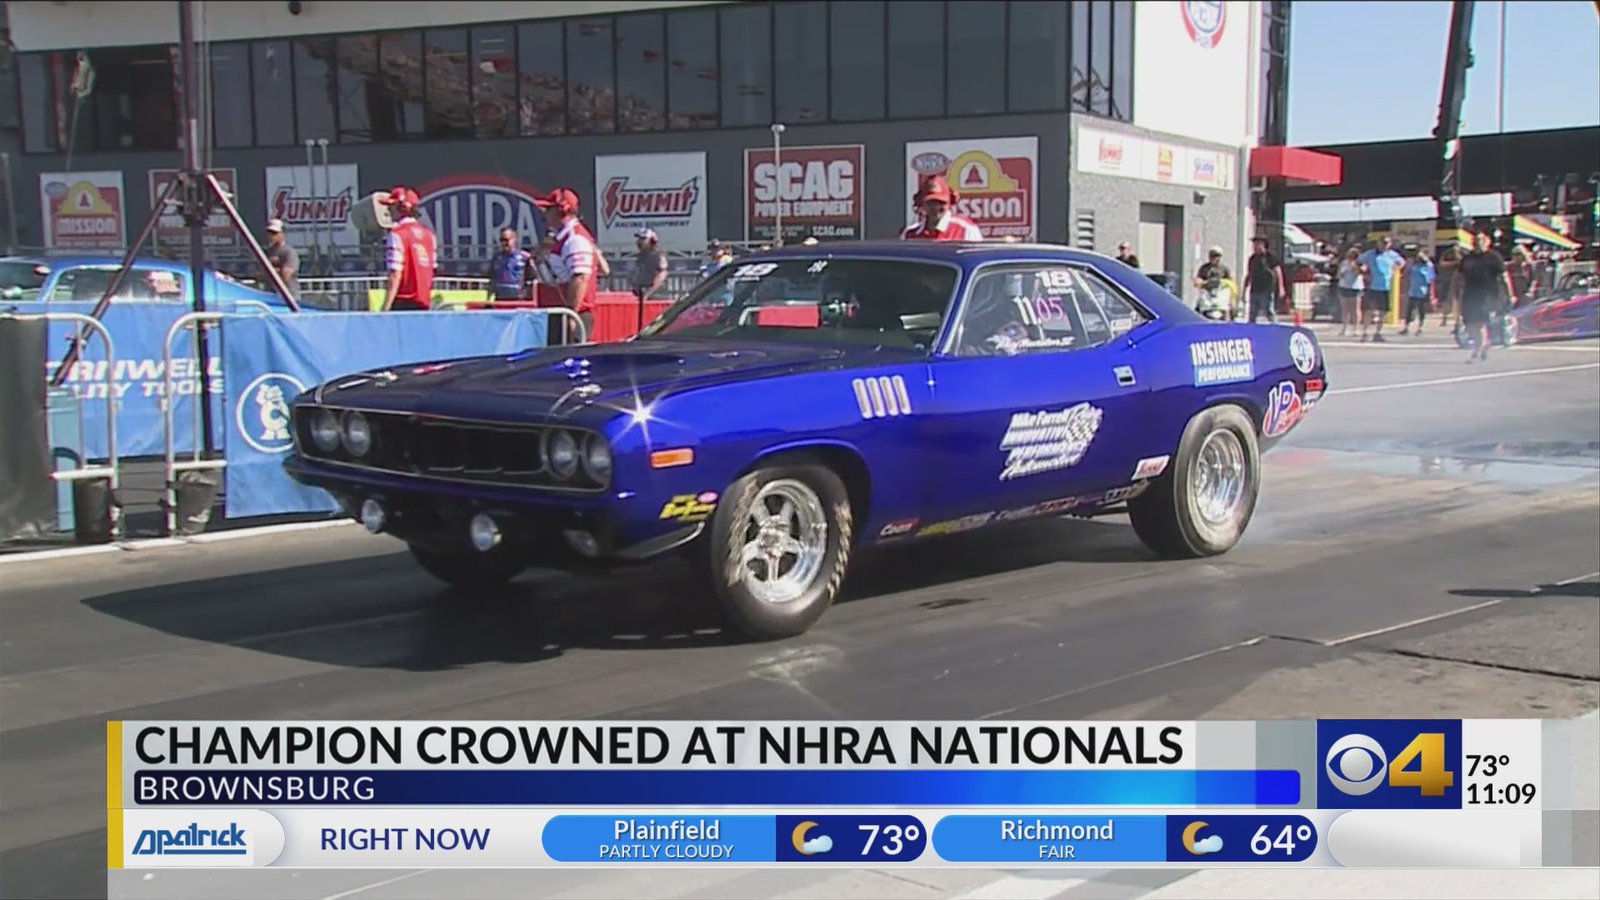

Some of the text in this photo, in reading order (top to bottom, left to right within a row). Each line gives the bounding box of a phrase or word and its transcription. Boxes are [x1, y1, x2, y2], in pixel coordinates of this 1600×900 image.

[754, 160, 854, 201] SCAG
[603, 178, 697, 221] SUMMIT
[417, 193, 539, 261] NHRA
[1036, 271, 1074, 287] 18
[1190, 338, 1254, 367] INSINGER
[46, 357, 222, 384] RNWELL
